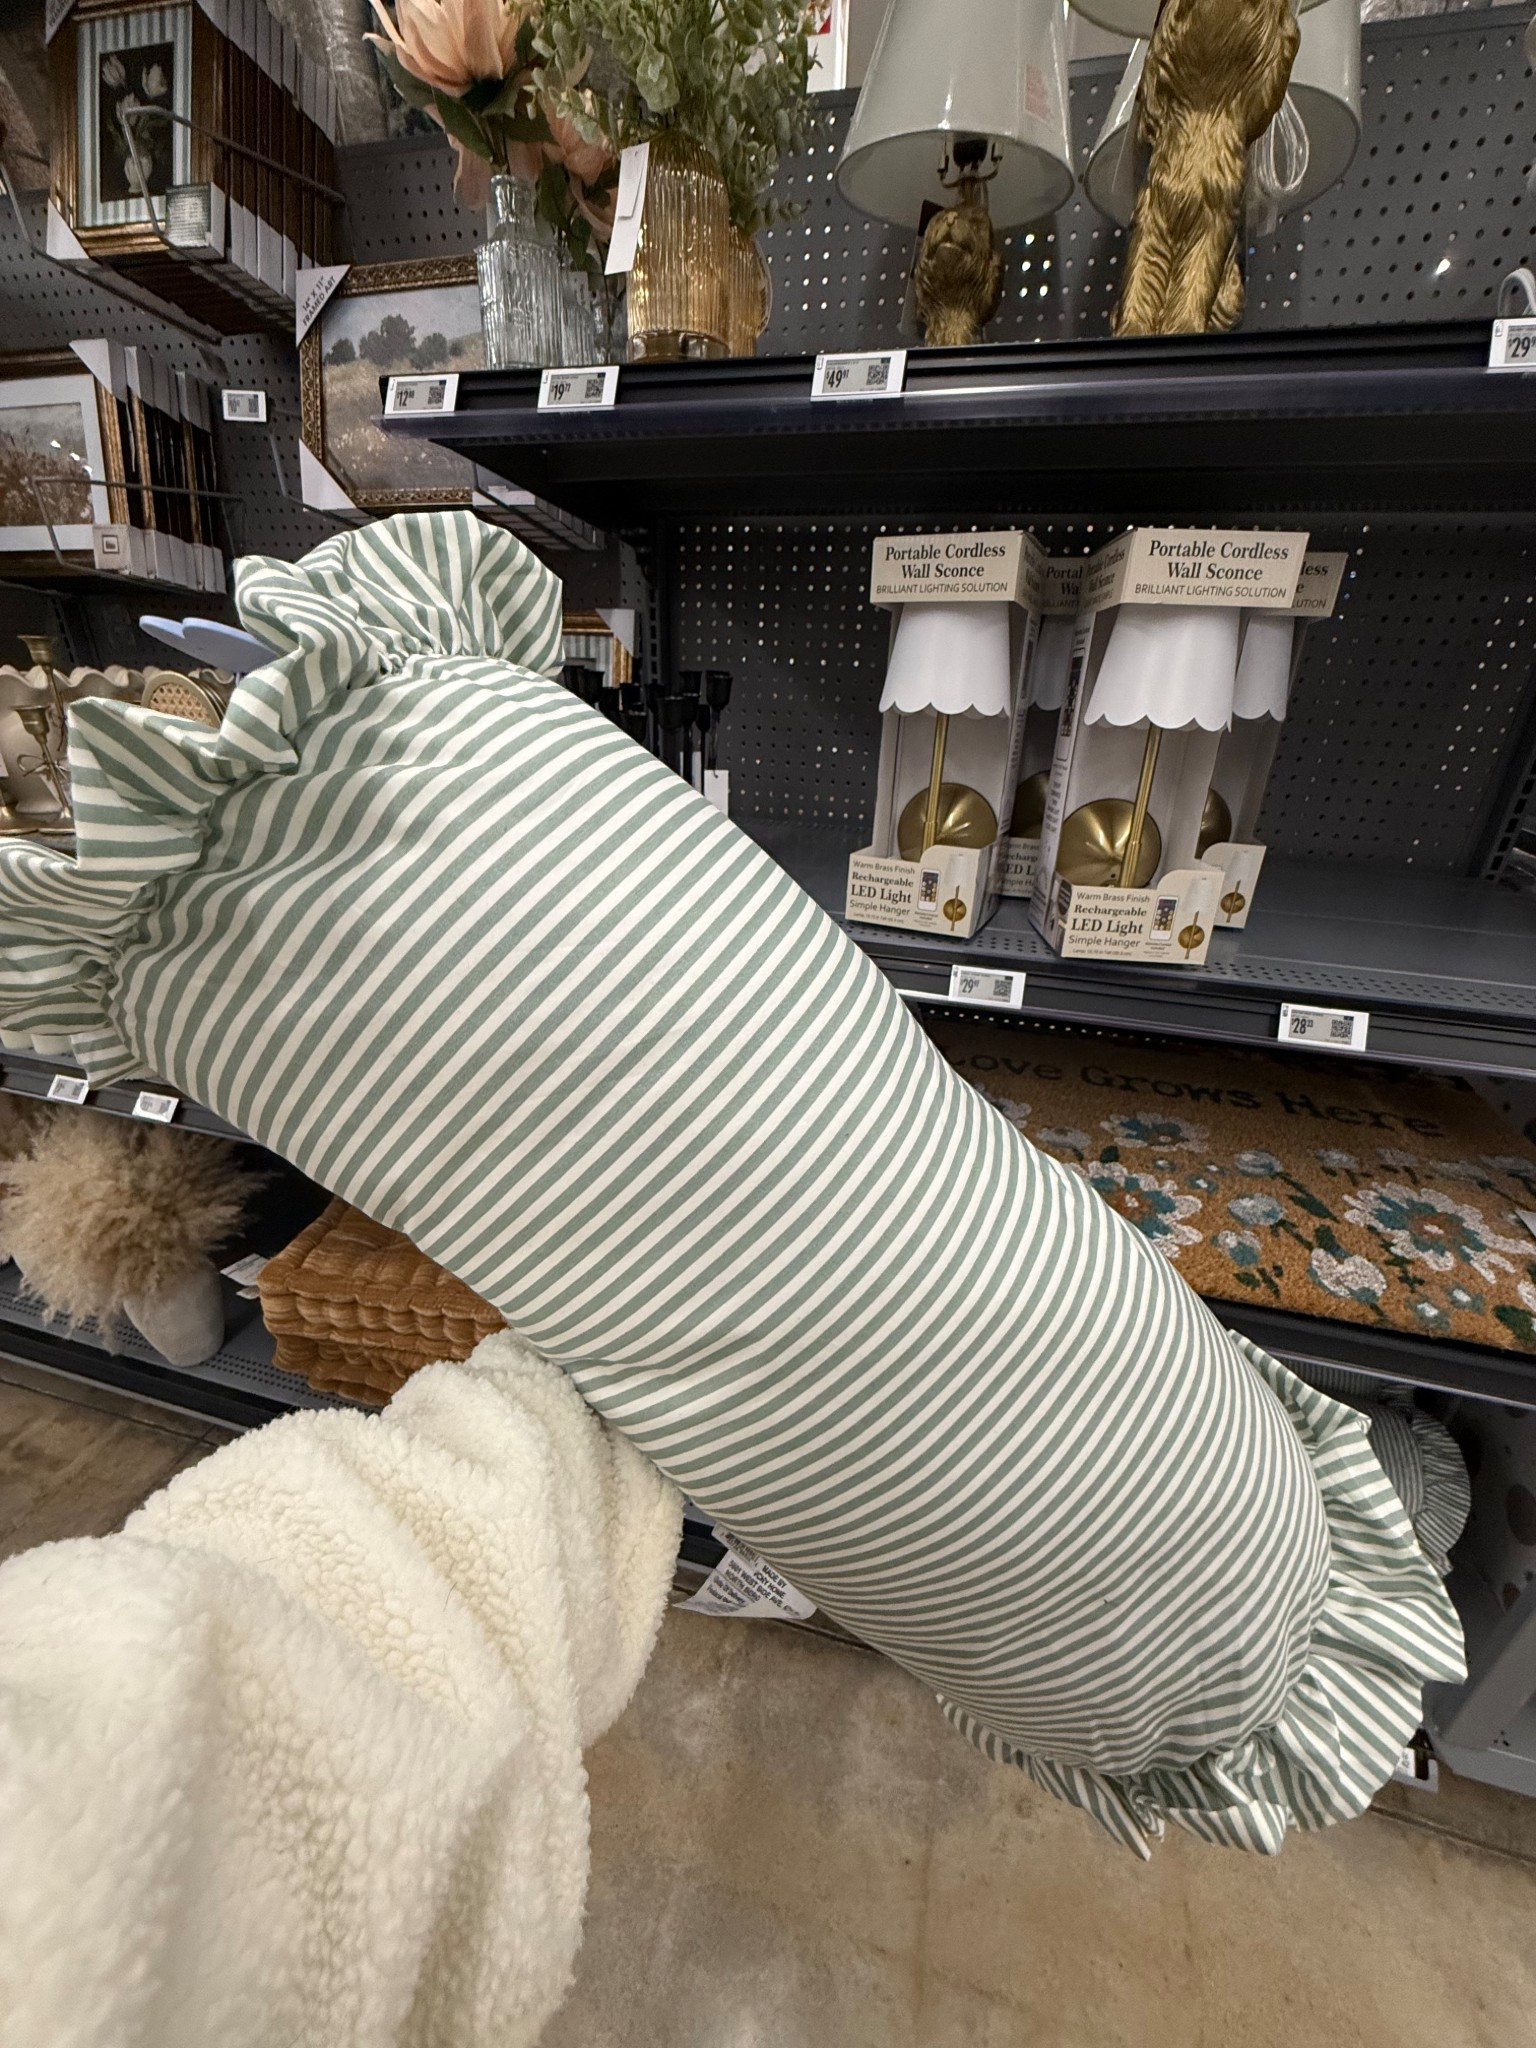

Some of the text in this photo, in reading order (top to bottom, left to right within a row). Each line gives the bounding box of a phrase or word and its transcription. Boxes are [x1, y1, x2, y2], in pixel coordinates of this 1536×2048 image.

[302, 275, 337, 326] FRAMED ART
[885, 542, 1006, 561] Portable Cordless
[1149, 540, 1290, 560] Portable Cordless
[901, 563, 985, 579] Wall Sconce
[1168, 562, 1263, 581] Wall Sconce
[876, 582, 1008, 595] BRILLIANT LIGHTING SOLUTION
[1135, 583, 1186, 595] BRILLIANT
[1186, 585, 1233, 597] LIGHTING
[1235, 586, 1287, 599] SOLUTION
[853, 861, 915, 874] Warm Brass Finish
[852, 871, 914, 888] Rechargeable
[851, 884, 911, 905] LED Light
[1077, 892, 1150, 903] Warm Brass Finish
[849, 899, 910, 917] Simple Hanger
[1074, 904, 1147, 917] Rechargeable
[1071, 918, 1143, 937] LED Light
[1068, 934, 1141, 949] Simple Hanger
[1080, 1065, 1263, 1110] Grows
[1275, 1088, 1446, 1138] Here
[740, 1570, 758, 1589] WEST
[761, 1564, 788, 1589] MADE BY
[767, 1583, 786, 1600] HOME
